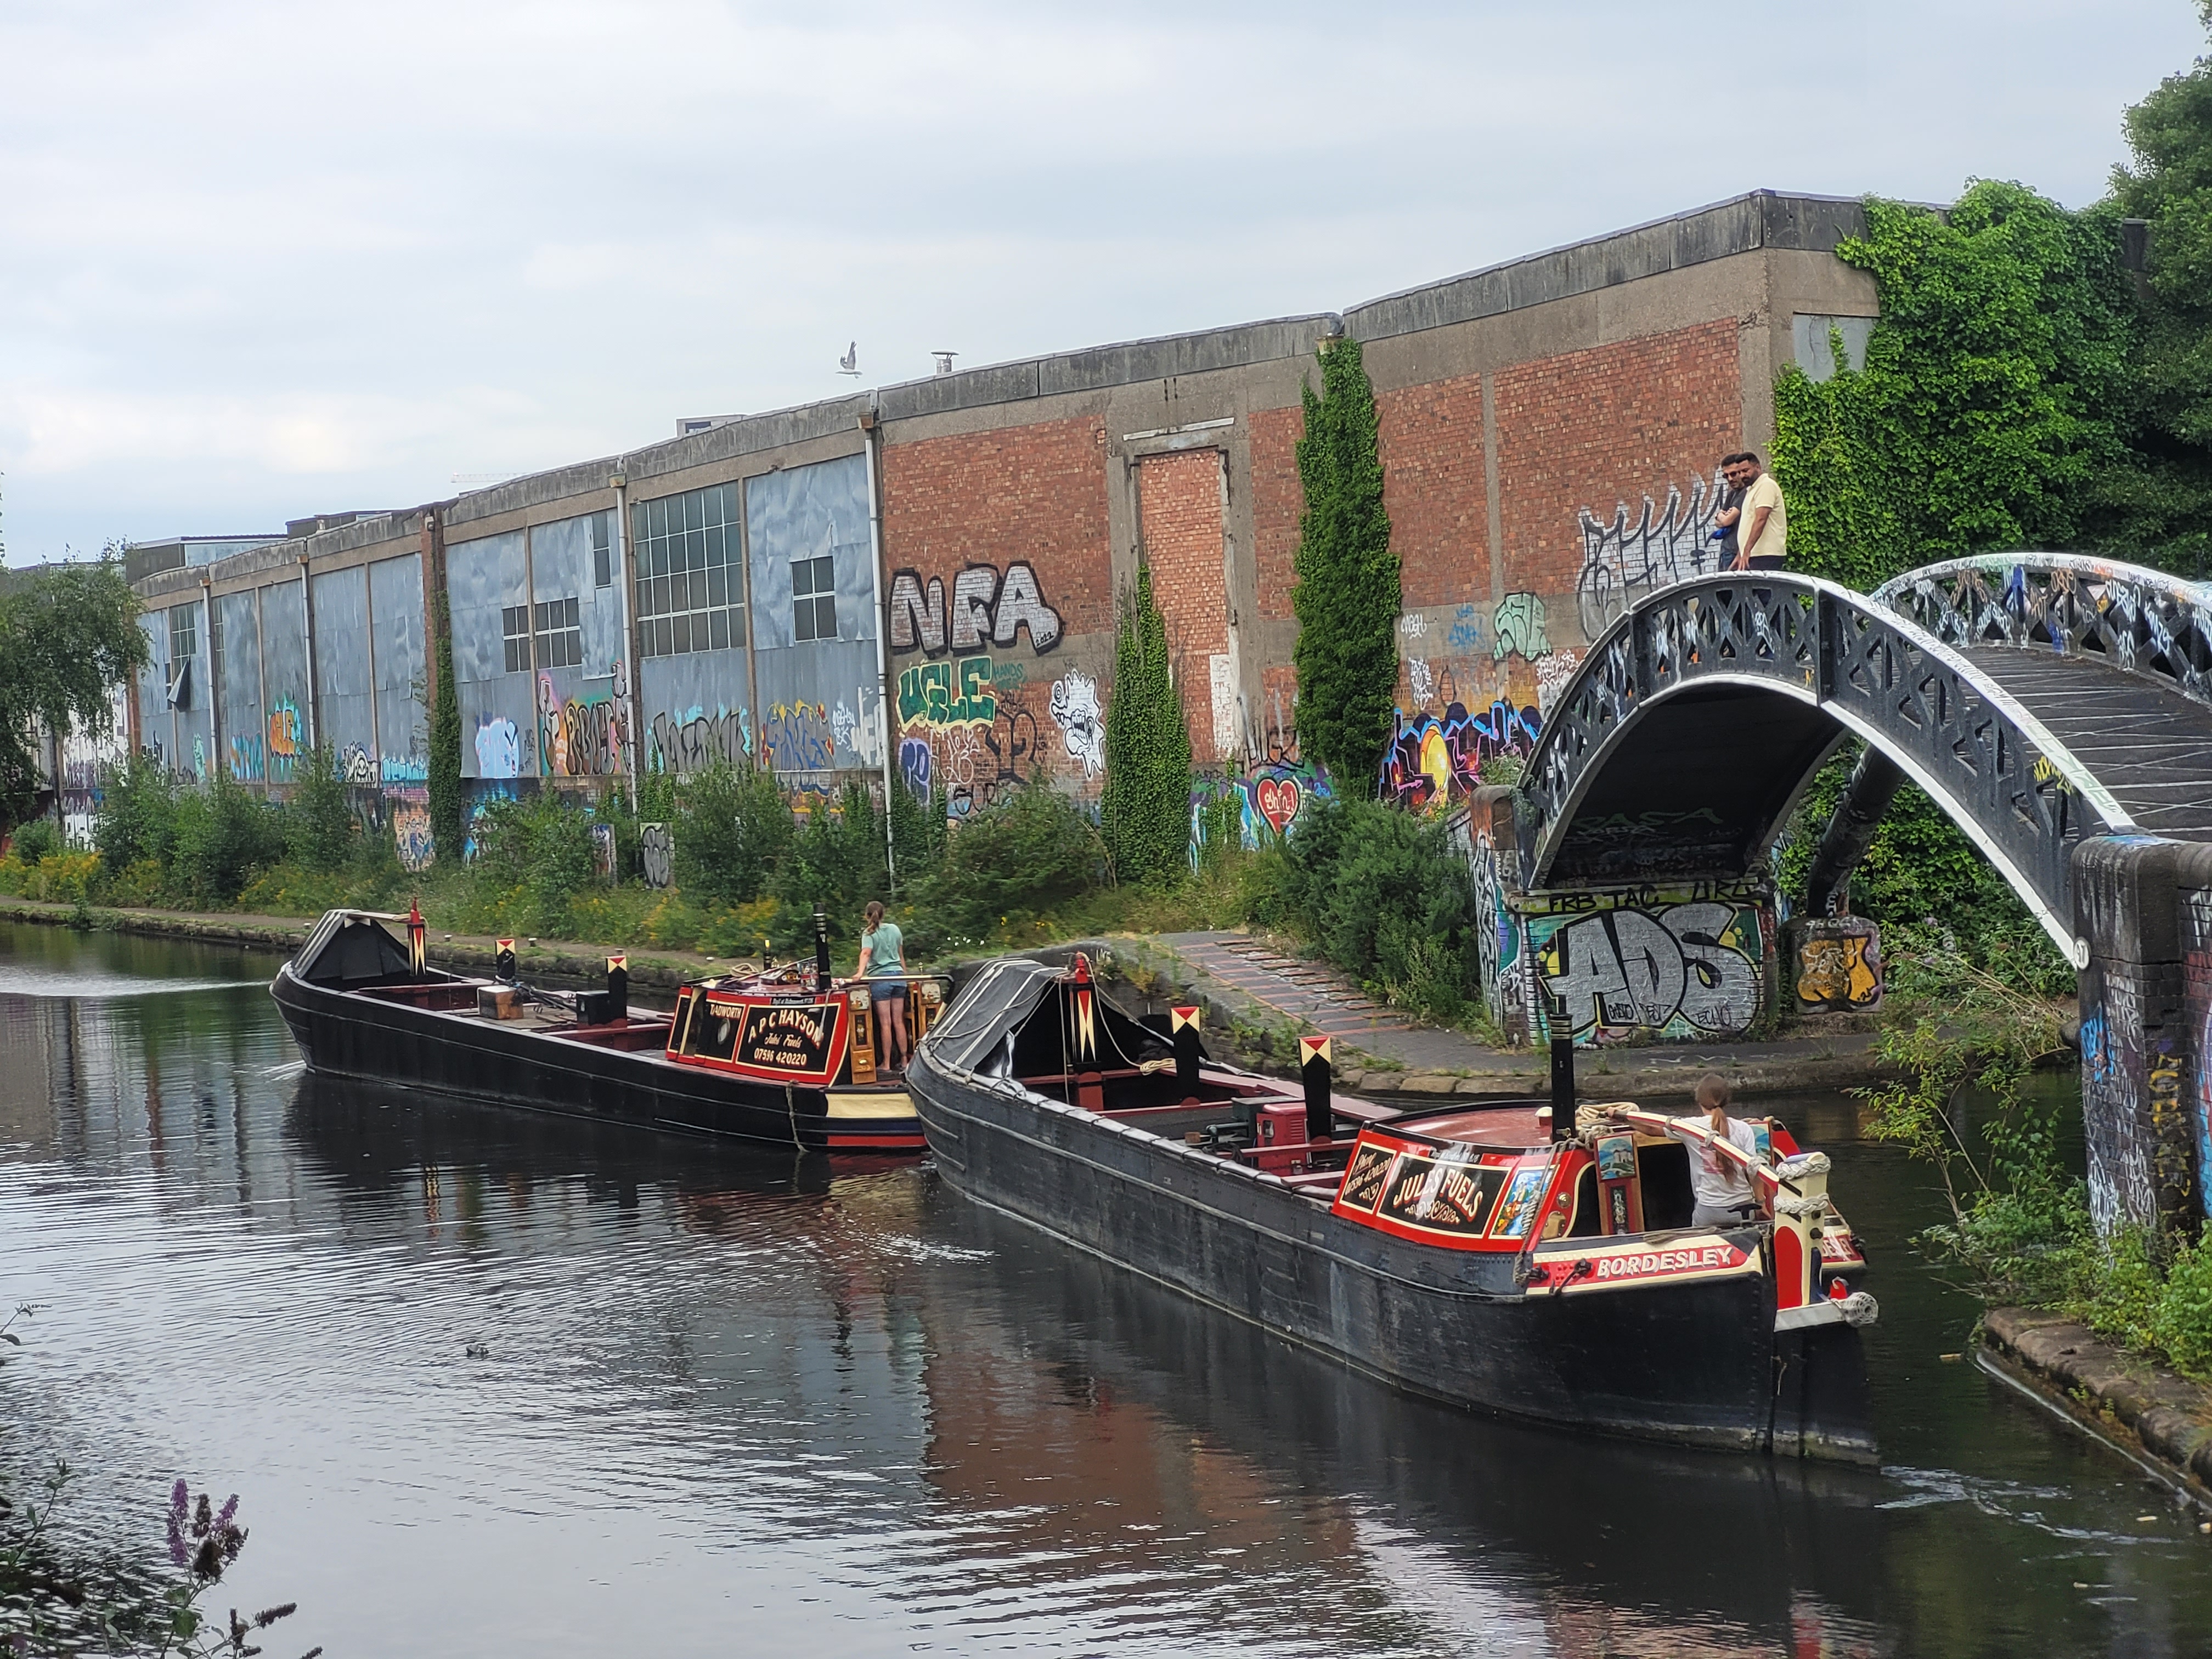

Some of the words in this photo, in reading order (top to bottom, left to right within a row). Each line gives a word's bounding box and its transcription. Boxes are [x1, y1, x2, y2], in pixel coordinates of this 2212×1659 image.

[1036, 631, 1054, 646] 2022
[710, 1004, 742, 1019] TADWORTH
[748, 1025, 757, 1043] A
[759, 1017, 767, 1034] P
[769, 1012, 777, 1028] C
[783, 1034, 803, 1048] Fuels
[754, 1047, 774, 1062] 07596
[776, 1051, 807, 1065] 420220
[1393, 1167, 1443, 1209] JULES
[1440, 1169, 1483, 1222] FUELS
[1597, 1246, 1733, 1280] BORDESLEY
